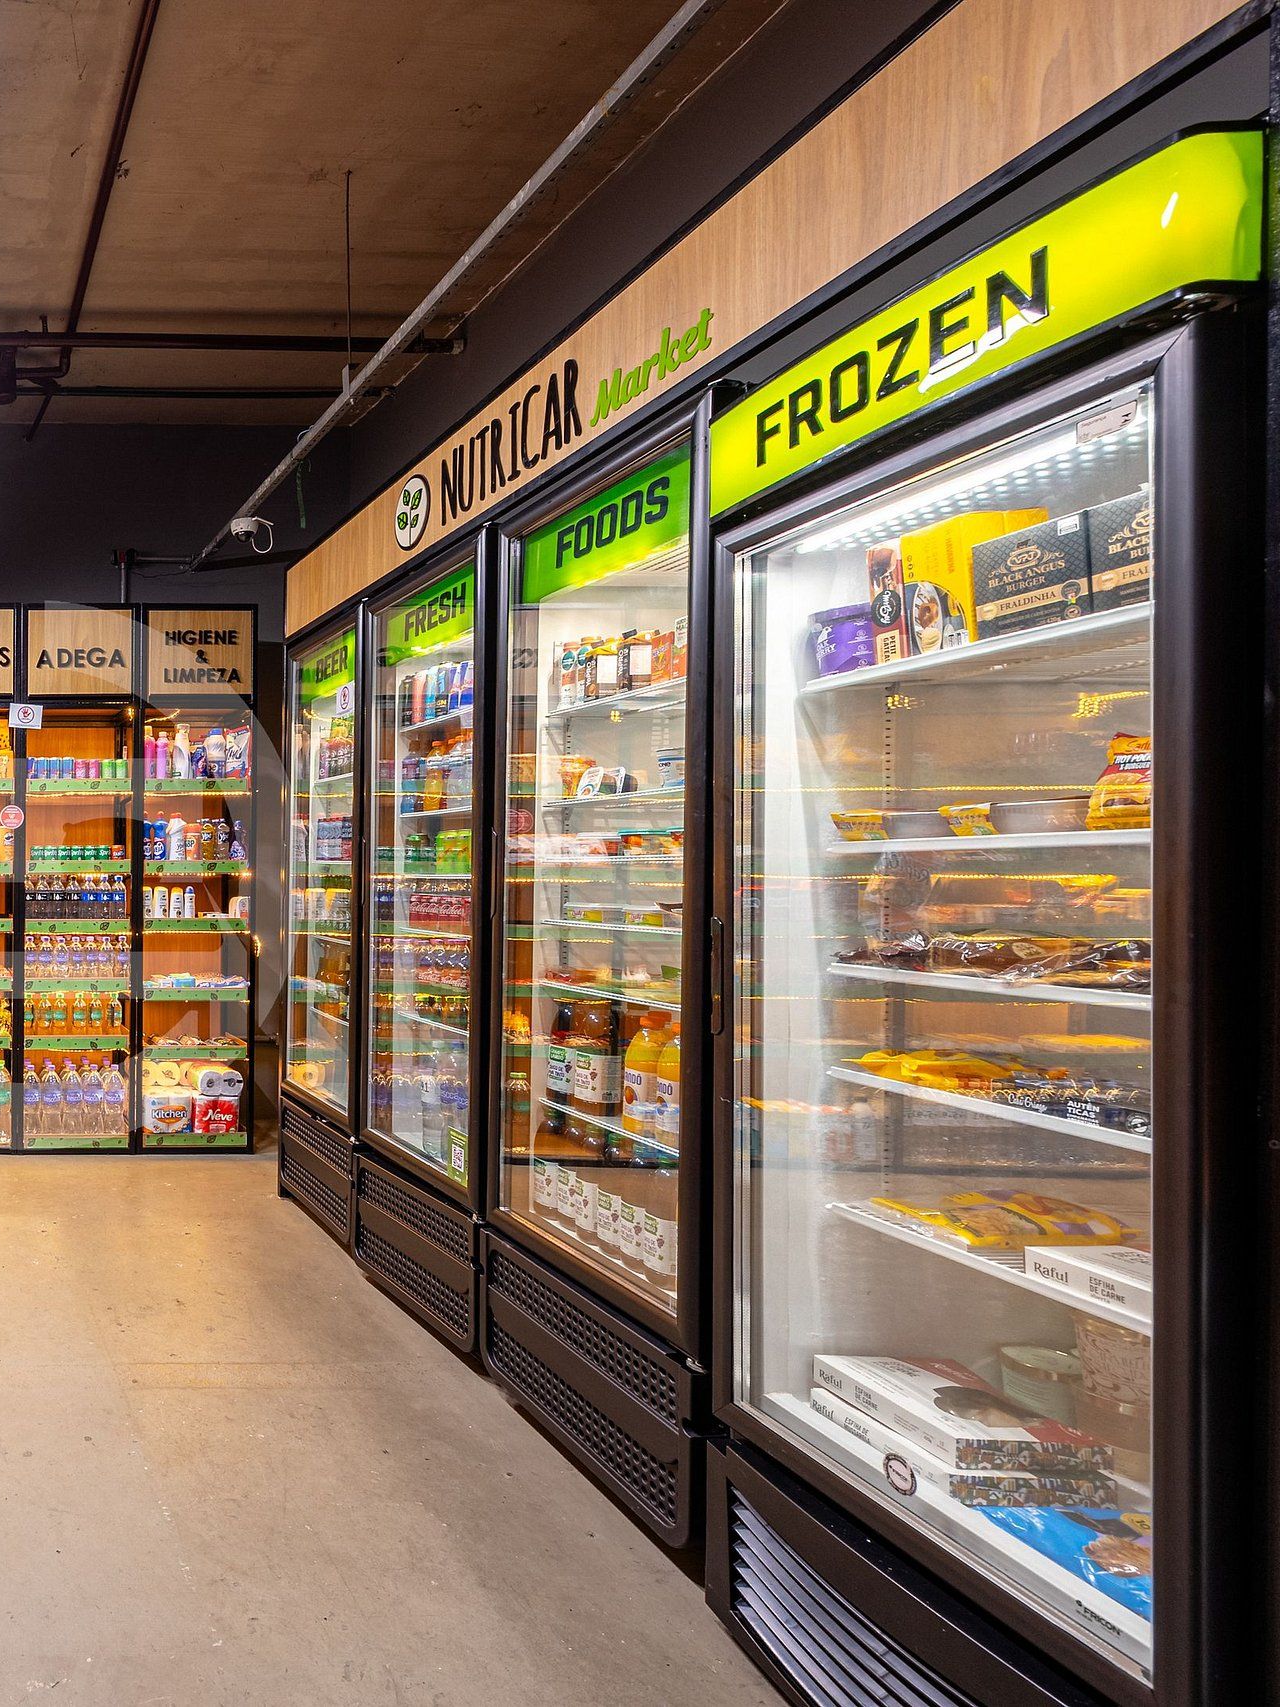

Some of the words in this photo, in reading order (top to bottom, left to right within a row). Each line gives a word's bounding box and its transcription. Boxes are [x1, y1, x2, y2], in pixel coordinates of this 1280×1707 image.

[755, 245, 1050, 469] FROZEN
[440, 358, 583, 527] NUTRICAR
[589, 307, 714, 427] Market
[555, 475, 671, 570] FOODS
[988, 571, 1023, 589] BLACK
[1026, 559, 1066, 578] ANGUS
[1006, 576, 1046, 593] BURGER
[1000, 591, 1057, 611] FRALDINHA
[404, 581, 466, 642] FRESH
[165, 629, 239, 647] HIGIENE
[889, 635, 897, 655] PETIT
[36, 647, 127, 670] ADEGA
[194, 649, 210, 665] &
[315, 645, 348, 684] BEER
[163, 667, 242, 685] LIMPEZA
[151, 1108, 188, 1119] Kitchen
[202, 1108, 234, 1122] Neve
[1033, 1261, 1069, 1283] Raful
[1089, 1276, 1116, 1292] ESFIHA
[1089, 1285, 1099, 1294] DE
[1100, 1289, 1126, 1304] CARNE
[819, 1368, 842, 1390] Raful
[854, 1385, 872, 1400] ESFIHA
[812, 1399, 835, 1420] Raful
[1083, 1606, 1121, 1636] FRICON
